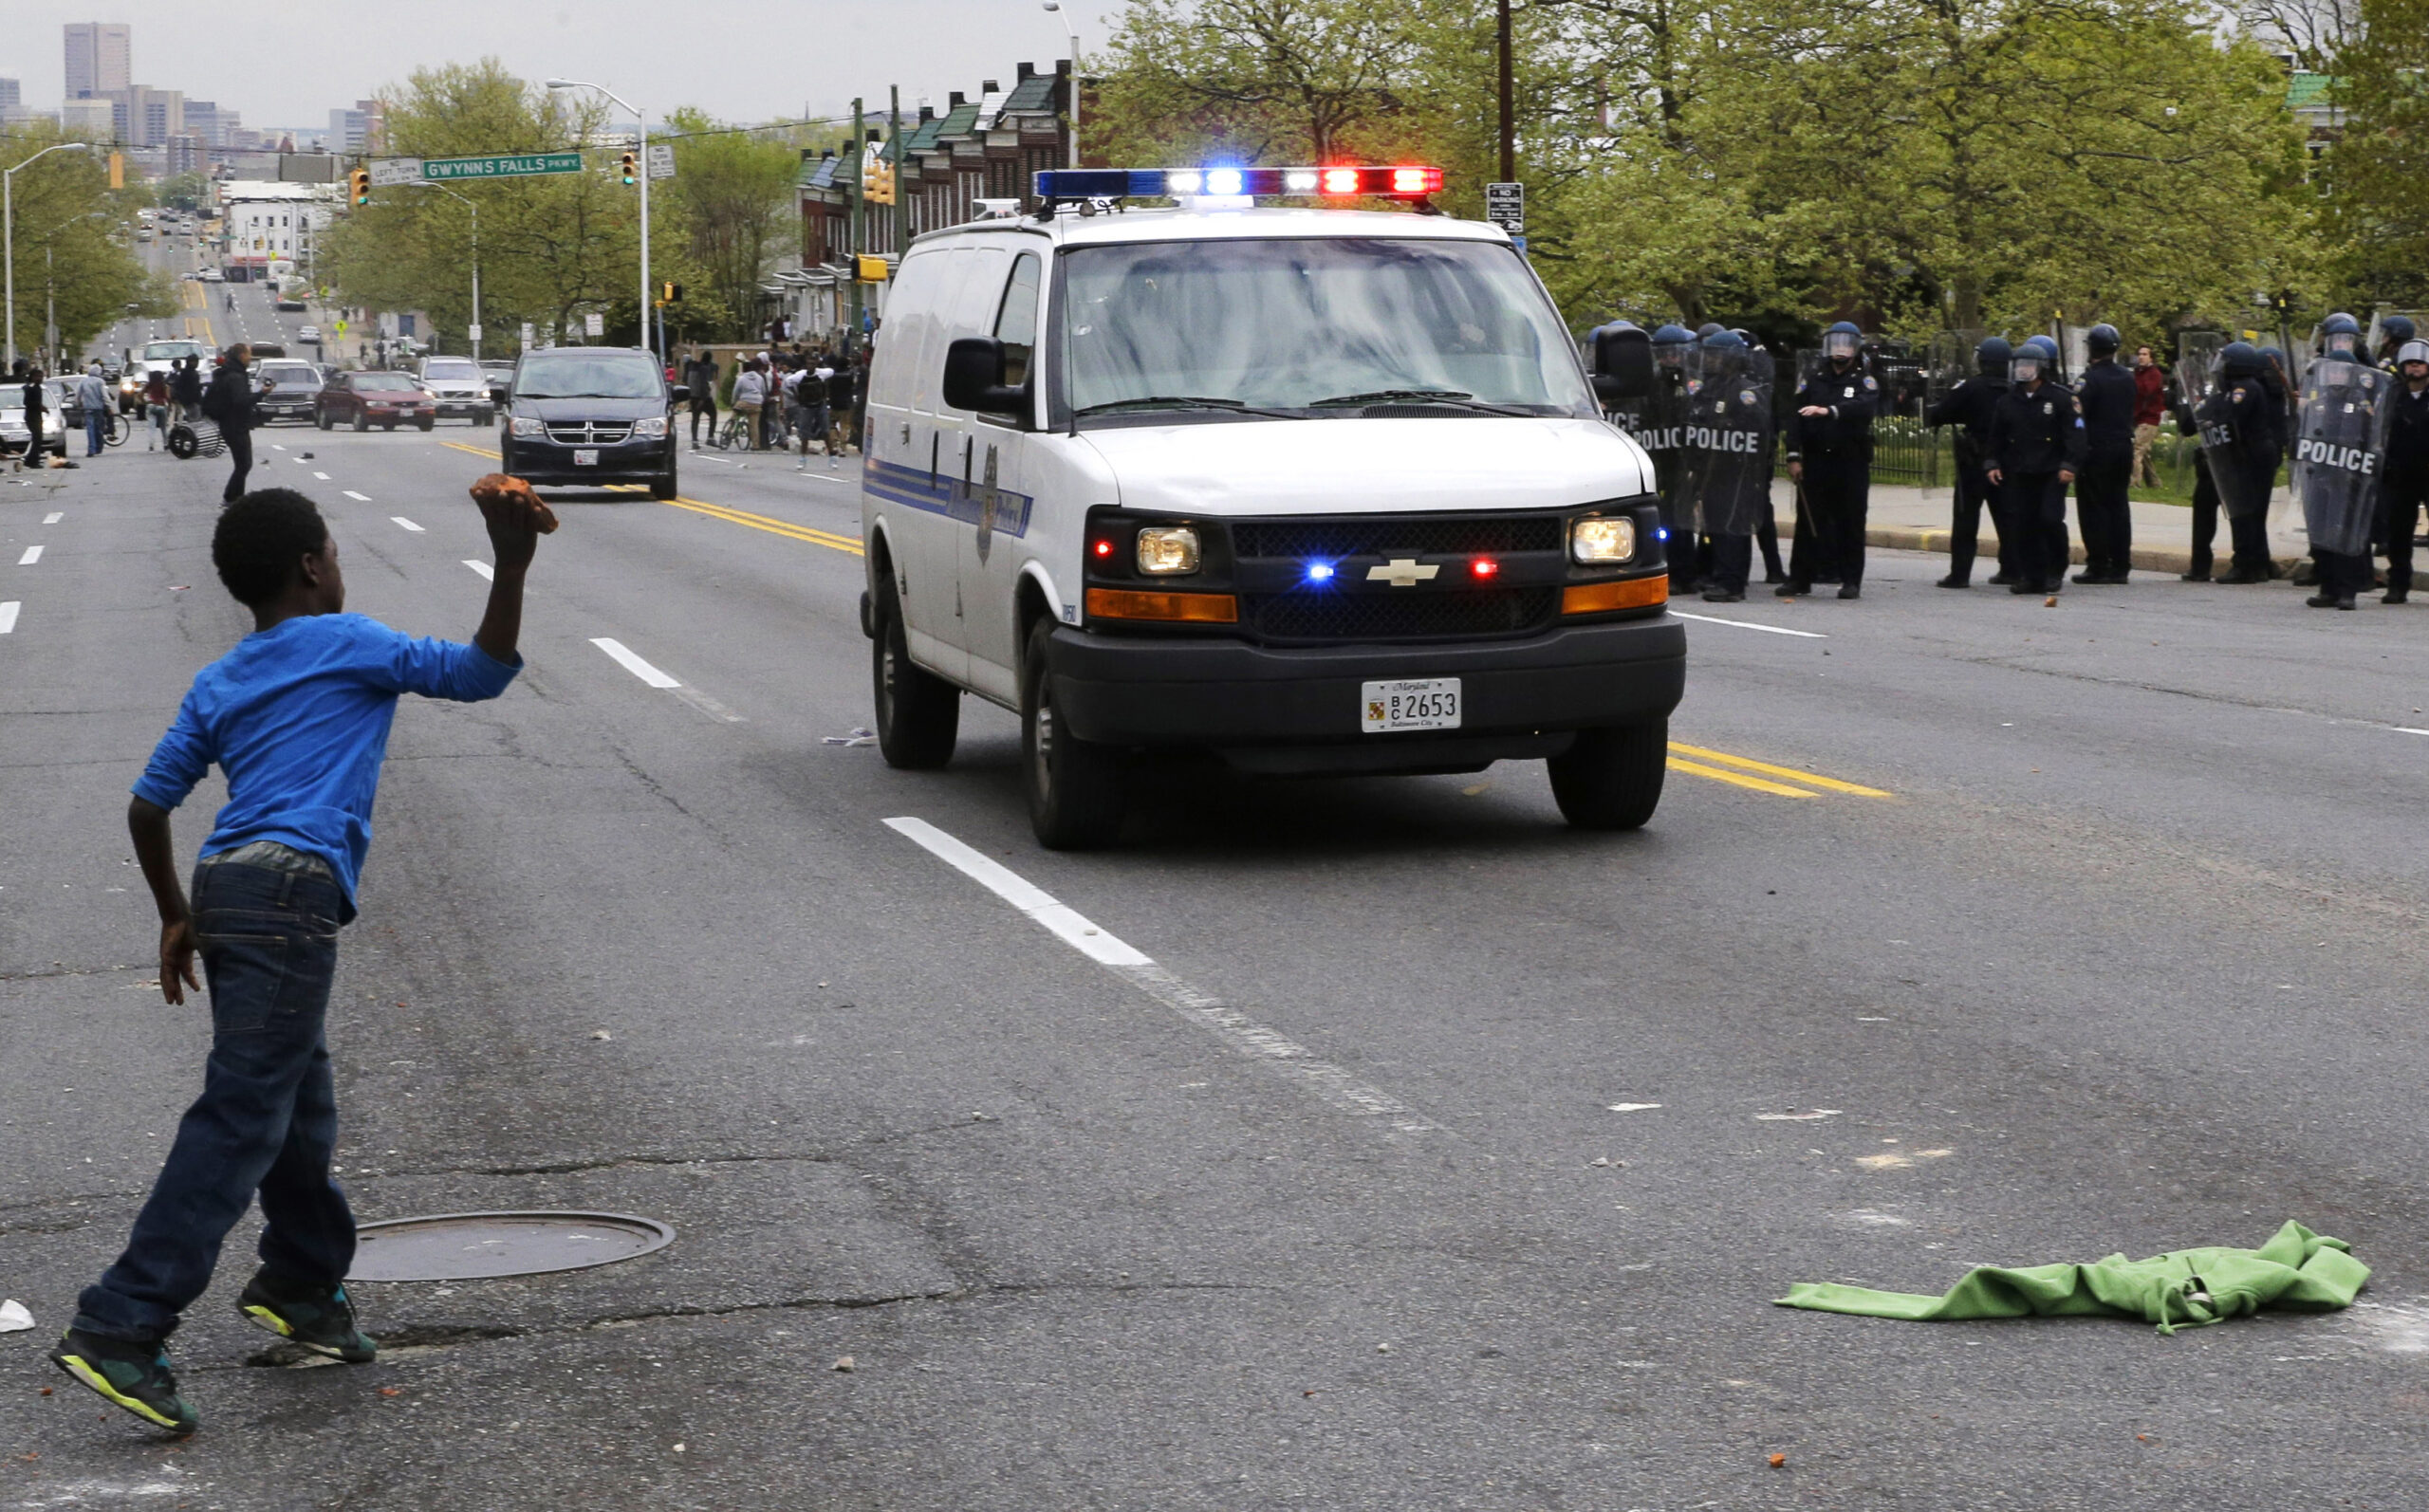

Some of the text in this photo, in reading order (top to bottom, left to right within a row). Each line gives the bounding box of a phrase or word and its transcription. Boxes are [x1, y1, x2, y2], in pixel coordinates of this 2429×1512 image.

[375, 168, 392, 177] LEFT
[428, 160, 494, 176] GWYNNS
[499, 157, 546, 173] FALLS
[1606, 412, 1640, 431] ICE
[1633, 427, 1682, 451] POLIC
[1685, 425, 1759, 453] POLICE
[2200, 424, 2232, 448] LICE
[2296, 438, 2376, 474] POLICE
[1392, 681, 1431, 692] Maryland
[1405, 692, 1456, 718] 2653
